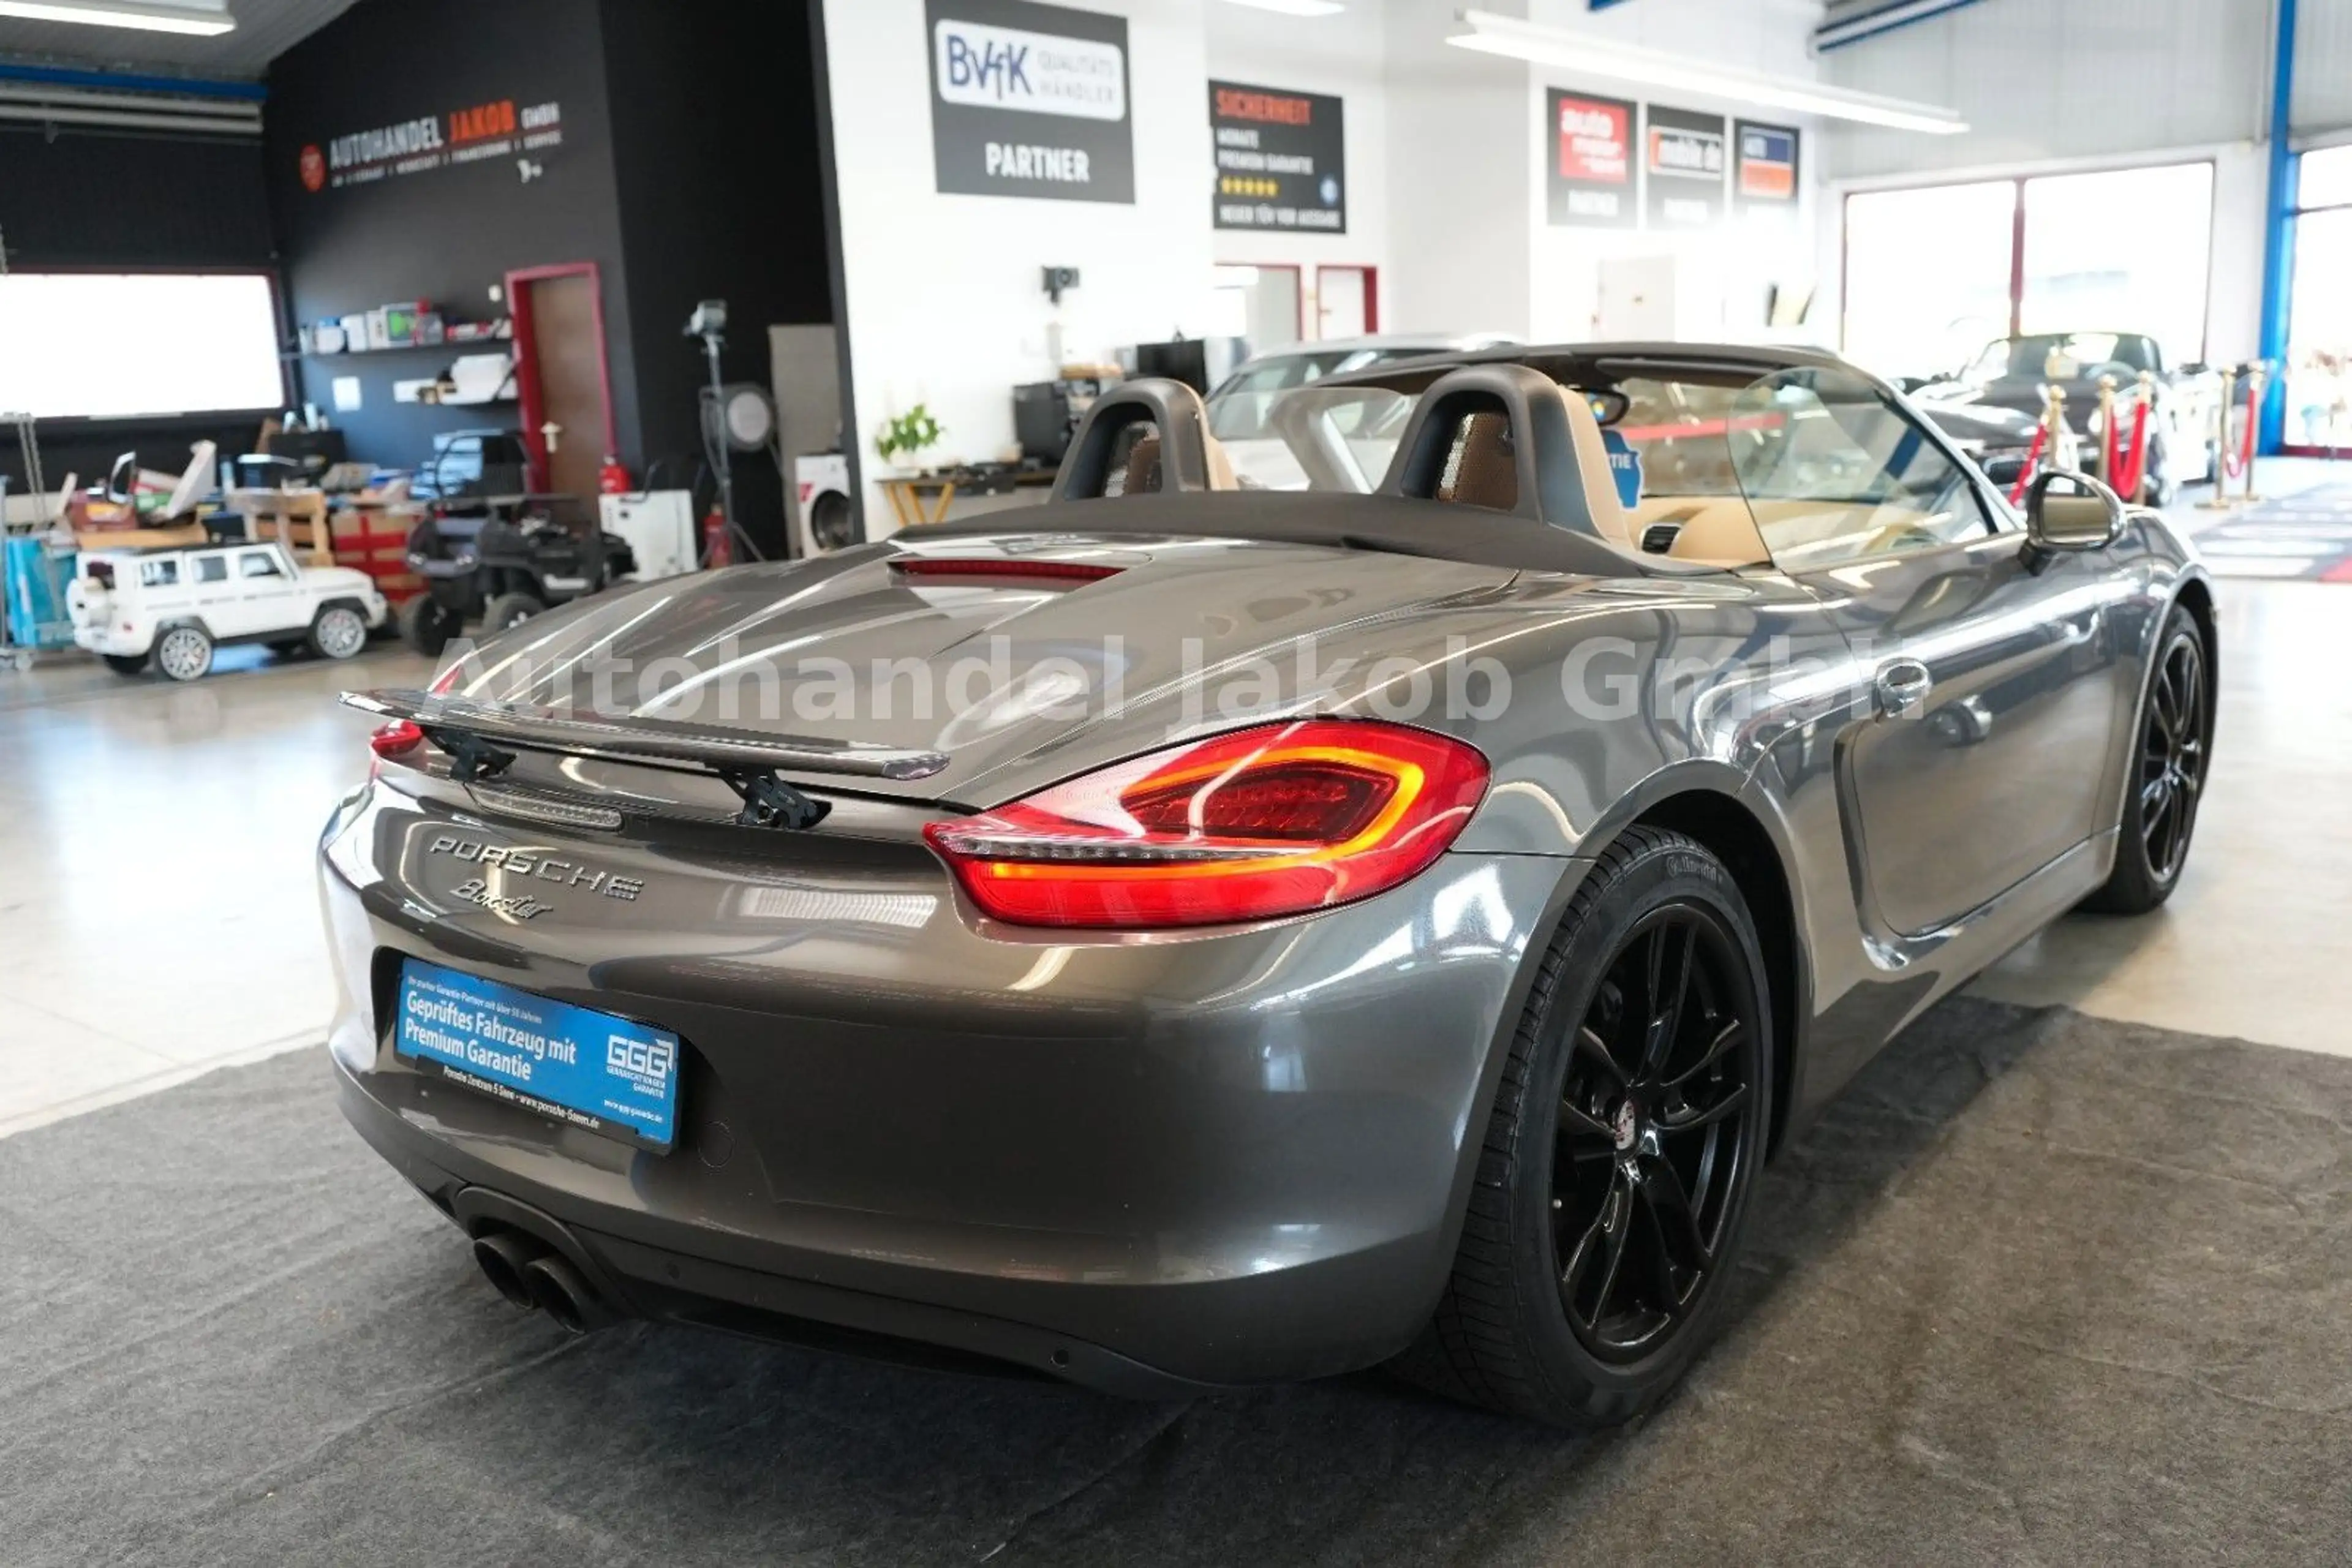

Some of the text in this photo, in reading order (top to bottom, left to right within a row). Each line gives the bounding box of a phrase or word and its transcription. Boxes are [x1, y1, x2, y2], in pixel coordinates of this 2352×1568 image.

[947, 34, 1033, 100] BVfK
[330, 115, 444, 170] AUTOHANDEL
[450, 99, 516, 142] JAKOB
[1216, 89, 1311, 126] SICHERHEIT
[985, 141, 1090, 183] PARTNER
[430, 835, 644, 901] PORSCHE
[450, 878, 554, 919] Boxster
[405, 1017, 532, 1081] Premium Garantie
[407, 990, 576, 1065] Geprüftes Fahrzeug mit
[607, 1034, 668, 1079] GGG
